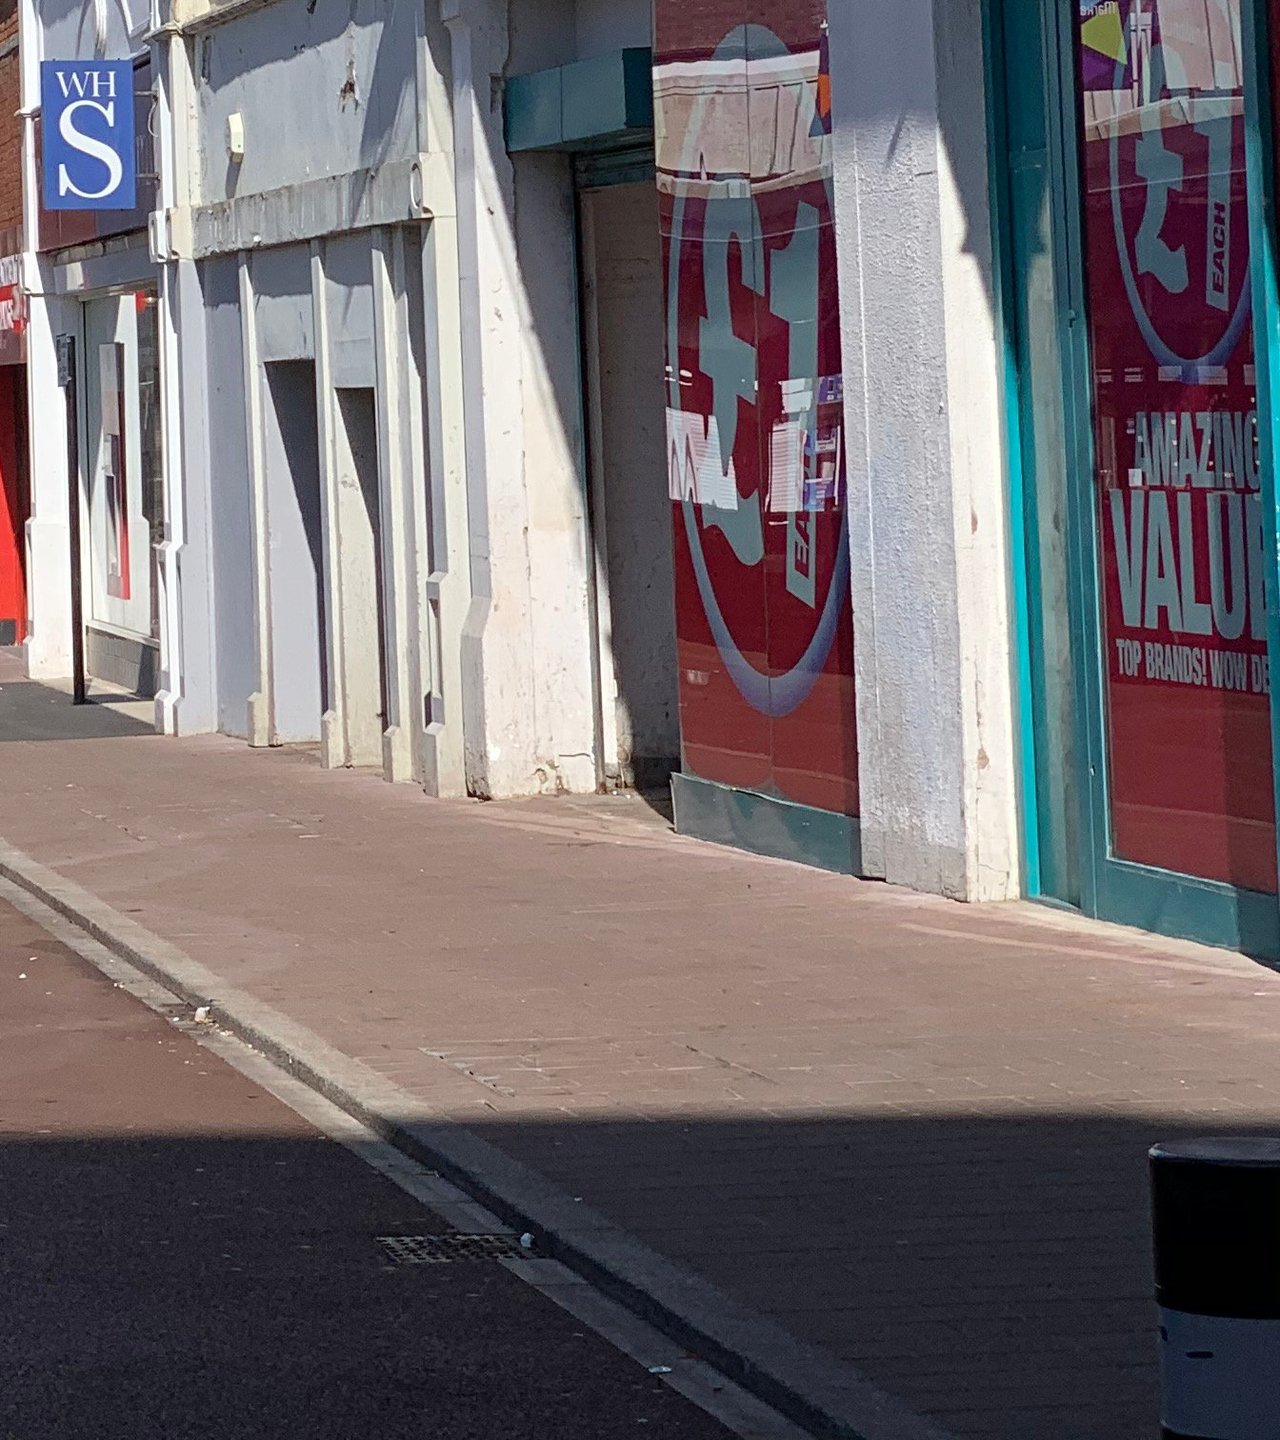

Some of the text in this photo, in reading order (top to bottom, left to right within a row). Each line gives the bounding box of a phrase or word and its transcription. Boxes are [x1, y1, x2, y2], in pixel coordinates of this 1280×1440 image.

[55, 71, 117, 98] WH
[58, 100, 123, 199] S
[1212, 201, 1226, 294] EACH
[1116, 639, 1141, 677] TOP
[1145, 641, 1207, 688] BRANDS!
[1209, 649, 1247, 693] WOW
